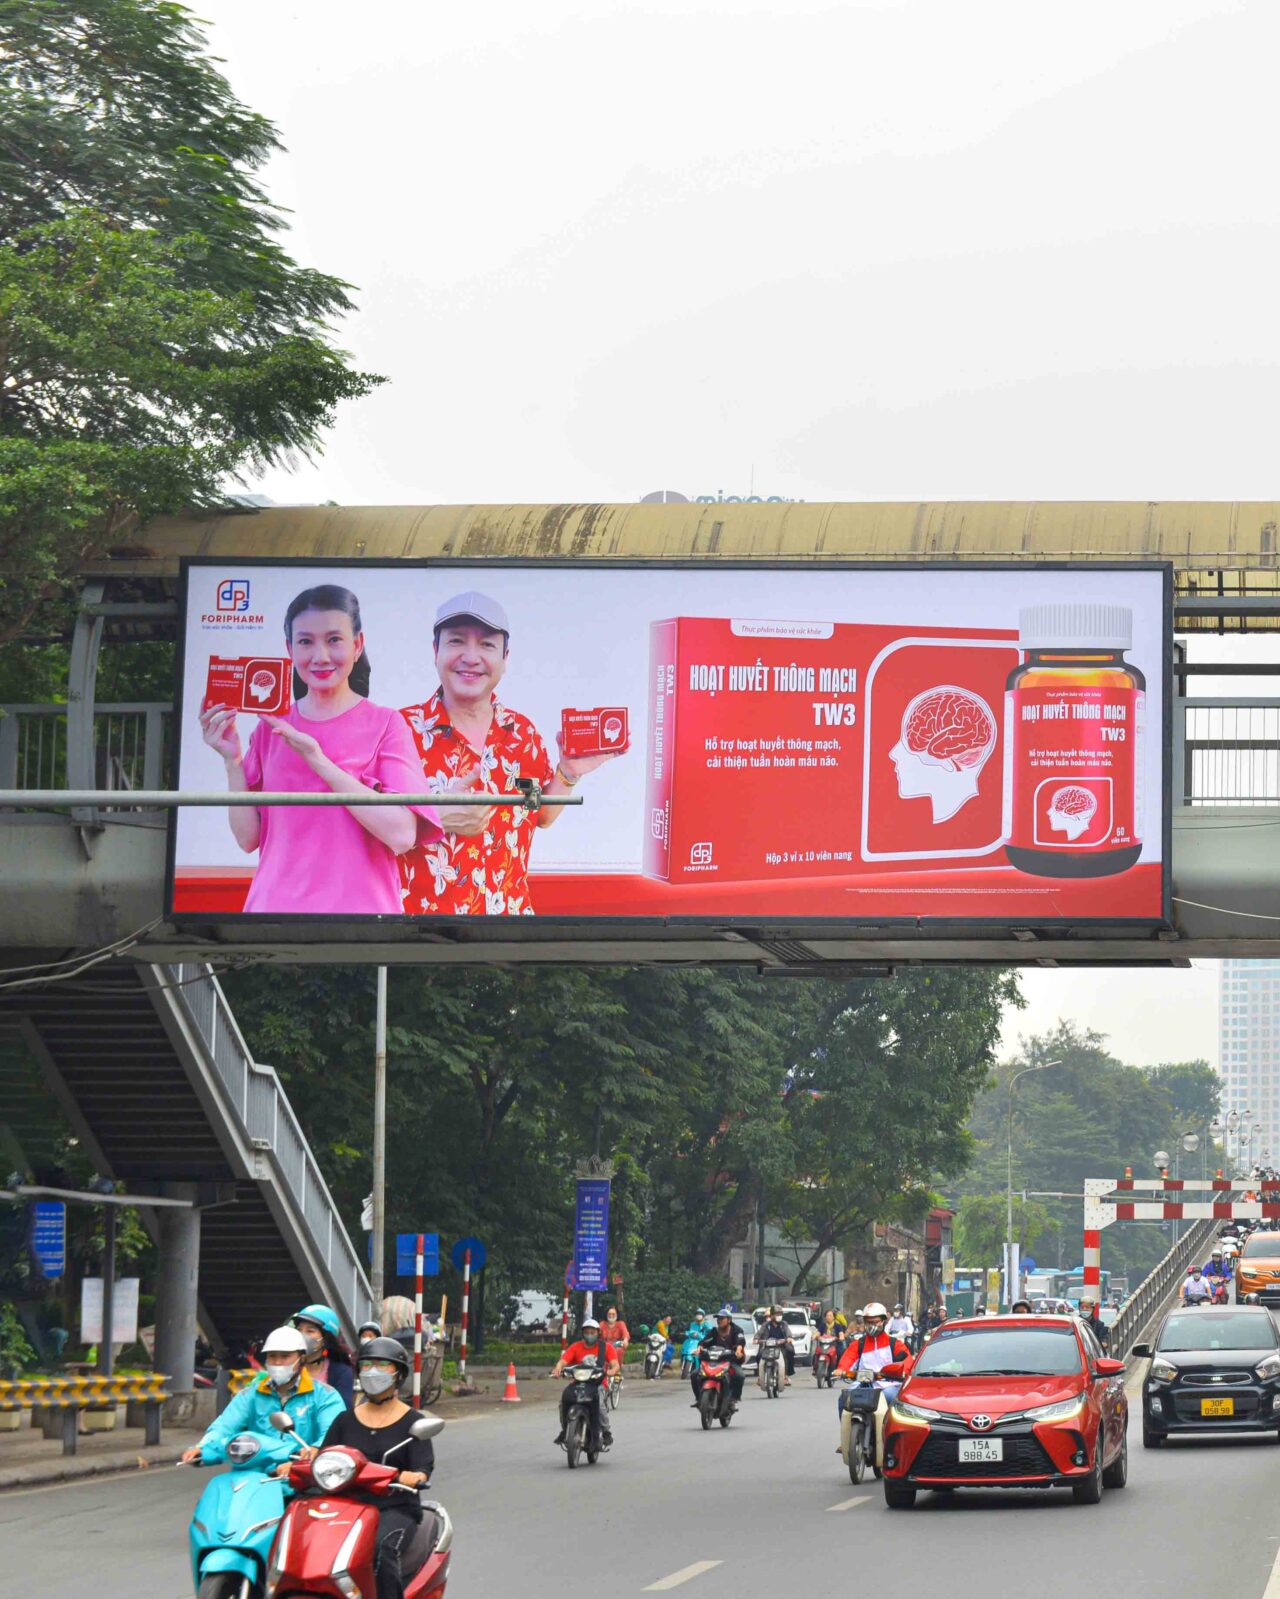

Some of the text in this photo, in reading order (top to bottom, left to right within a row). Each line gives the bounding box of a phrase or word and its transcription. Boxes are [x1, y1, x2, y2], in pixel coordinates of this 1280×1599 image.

[201, 615, 264, 623] FORIPHARM
[666, 664, 675, 696] TW3
[690, 657, 857, 698] HOẠT HUYẾT THÔNG MẠCH
[812, 703, 856, 726] TW3
[1022, 699, 1126, 724] HOẠT HUYẾT THÔNG MẠCH
[1100, 727, 1126, 741] TW3
[705, 736, 842, 752] Hỗ trợ hoạt huyết thông mạch,
[706, 753, 839, 769] cải thiện tuần hoàn máu não.
[766, 853, 782, 865] Hộp
[783, 853, 789, 862] 3
[799, 853, 804, 862] x
[805, 851, 815, 861] 10
[816, 850, 832, 860] viên
[834, 852, 853, 862] nang
[683, 864, 719, 872] FORIPHARM
[972, 1440, 990, 1450] 15A
